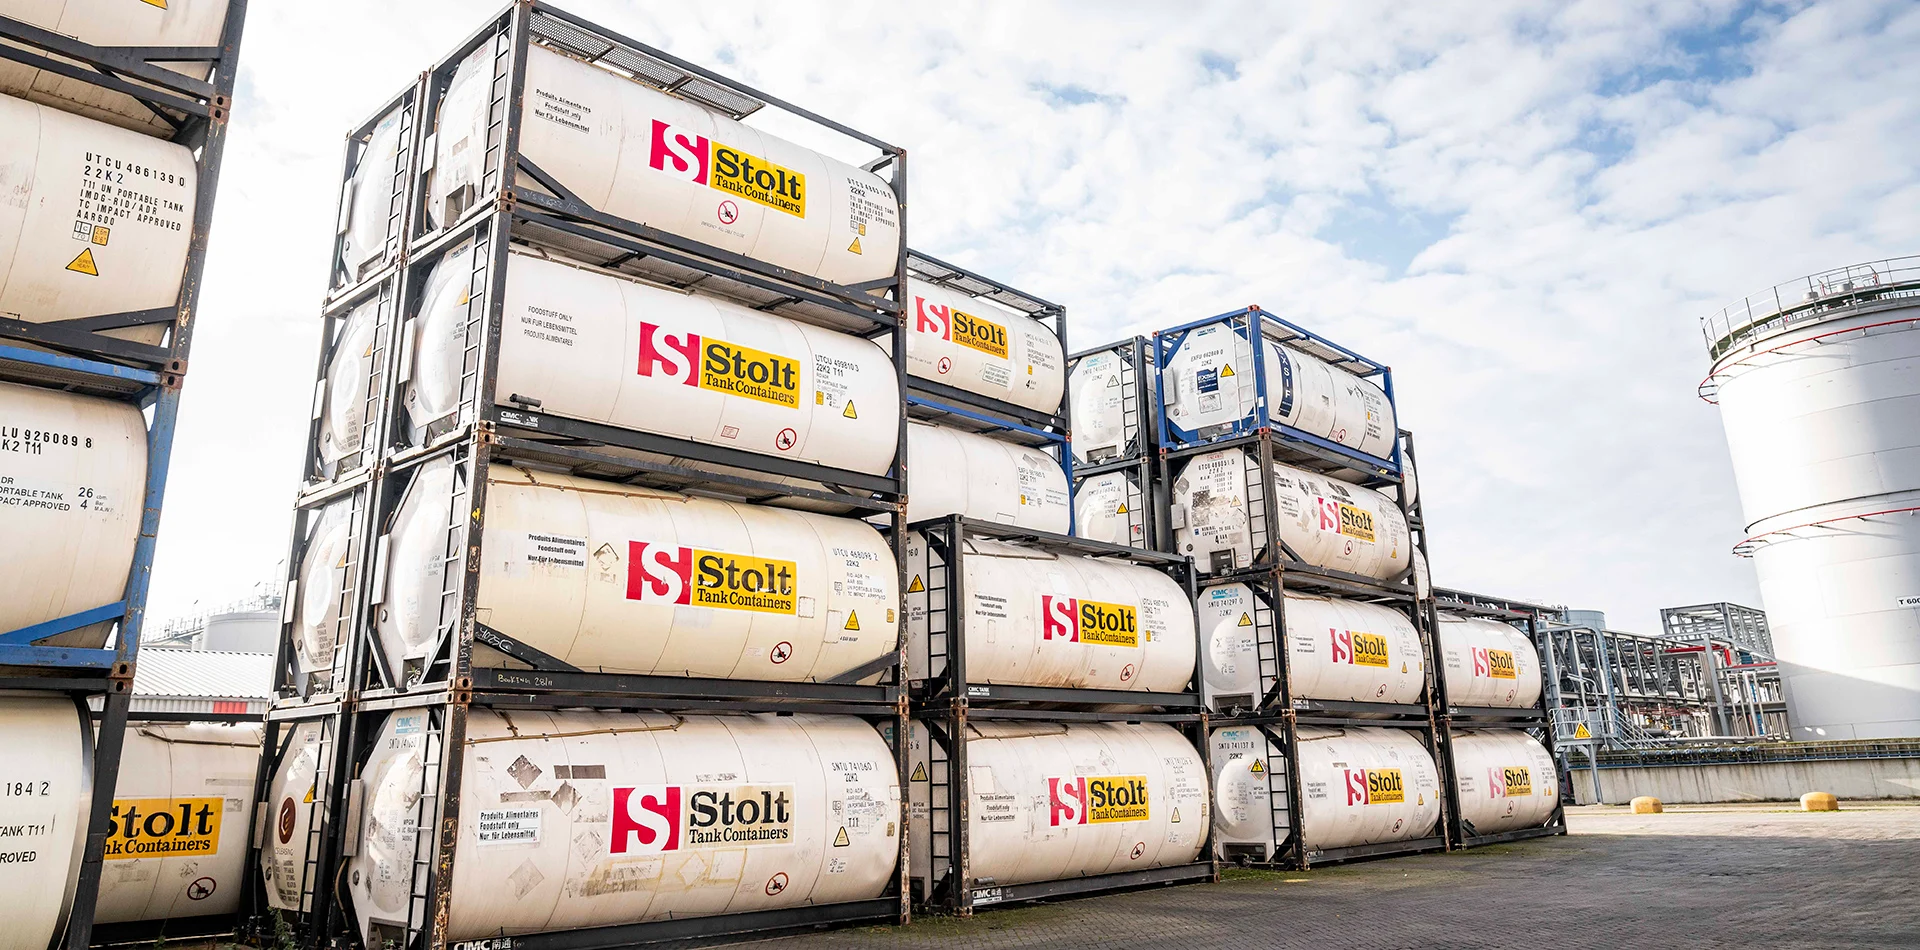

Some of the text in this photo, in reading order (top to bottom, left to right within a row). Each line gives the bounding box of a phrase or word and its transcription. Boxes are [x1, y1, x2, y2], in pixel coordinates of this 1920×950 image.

[84, 165, 124, 184] 22K2
[85, 152, 185, 187] UTCU 486139 0
[715, 149, 801, 201] Stolt
[80, 189, 158, 215] IMDG-RID/ADR
[83, 179, 184, 213] T11 UN PORTABLE TANK
[715, 174, 801, 214] Tank Containers
[76, 209, 115, 226] AAR600
[79, 199, 182, 232] TC IMPACT APPROVED
[528, 305, 573, 322] FOODSTUFF ONLY
[521, 316, 532, 325] NUR
[543, 320, 578, 336] LEBENSMITTEL
[953, 312, 1006, 346] Stolt
[954, 331, 972, 345] Tank
[971, 337, 1006, 356] Containers
[704, 343, 796, 391] Stolt
[815, 354, 833, 365] UTCU
[816, 363, 831, 375] 22K2
[833, 367, 844, 377] T11
[704, 372, 735, 392] Tank
[735, 379, 795, 406] Containers
[501, 410, 520, 420] CIMC
[2, 439, 42, 455] K2 T11
[24, 429, 78, 447] 926089
[85, 437, 93, 449] 8
[40, 490, 64, 500] TANK
[78, 487, 94, 498] 26
[23, 499, 71, 512] APPROVED
[80, 499, 88, 510] 4
[1341, 506, 1373, 532] Stolt
[528, 533, 586, 547] Produits Alimentaires
[537, 545, 564, 554] Foodstuff
[846, 559, 860, 568] 22K2
[697, 555, 792, 596] Stolt
[697, 588, 792, 611] Tank Containers
[1211, 588, 1228, 596] CIMC
[1081, 603, 1135, 633] Stolt
[1219, 609, 1232, 617] 22K2
[1082, 629, 1100, 642] Tank
[1100, 631, 1136, 645] Containers
[1353, 634, 1387, 656] Stolt
[1489, 650, 1514, 669] Stolt
[396, 717, 412, 728] CIMC
[1218, 742, 1230, 750] SNTU
[831, 762, 848, 771] SNTU
[1368, 772, 1402, 792] Stolt
[1504, 769, 1530, 787] Stolt
[6, 781, 49, 797] 184 2
[1090, 779, 1146, 808] Stolt
[480, 810, 539, 820] Produits Alimentaires
[689, 790, 789, 828] Stolt
[1091, 806, 1147, 819] Tank Containers
[28, 824, 46, 836] T11
[480, 820, 520, 830] Foodstuff only
[479, 832, 490, 840] Nur
[501, 829, 536, 839] Lebensmittel
[689, 826, 789, 844] Tank Containers
[125, 838, 211, 854] Containers
[972, 888, 991, 899] CIMC
